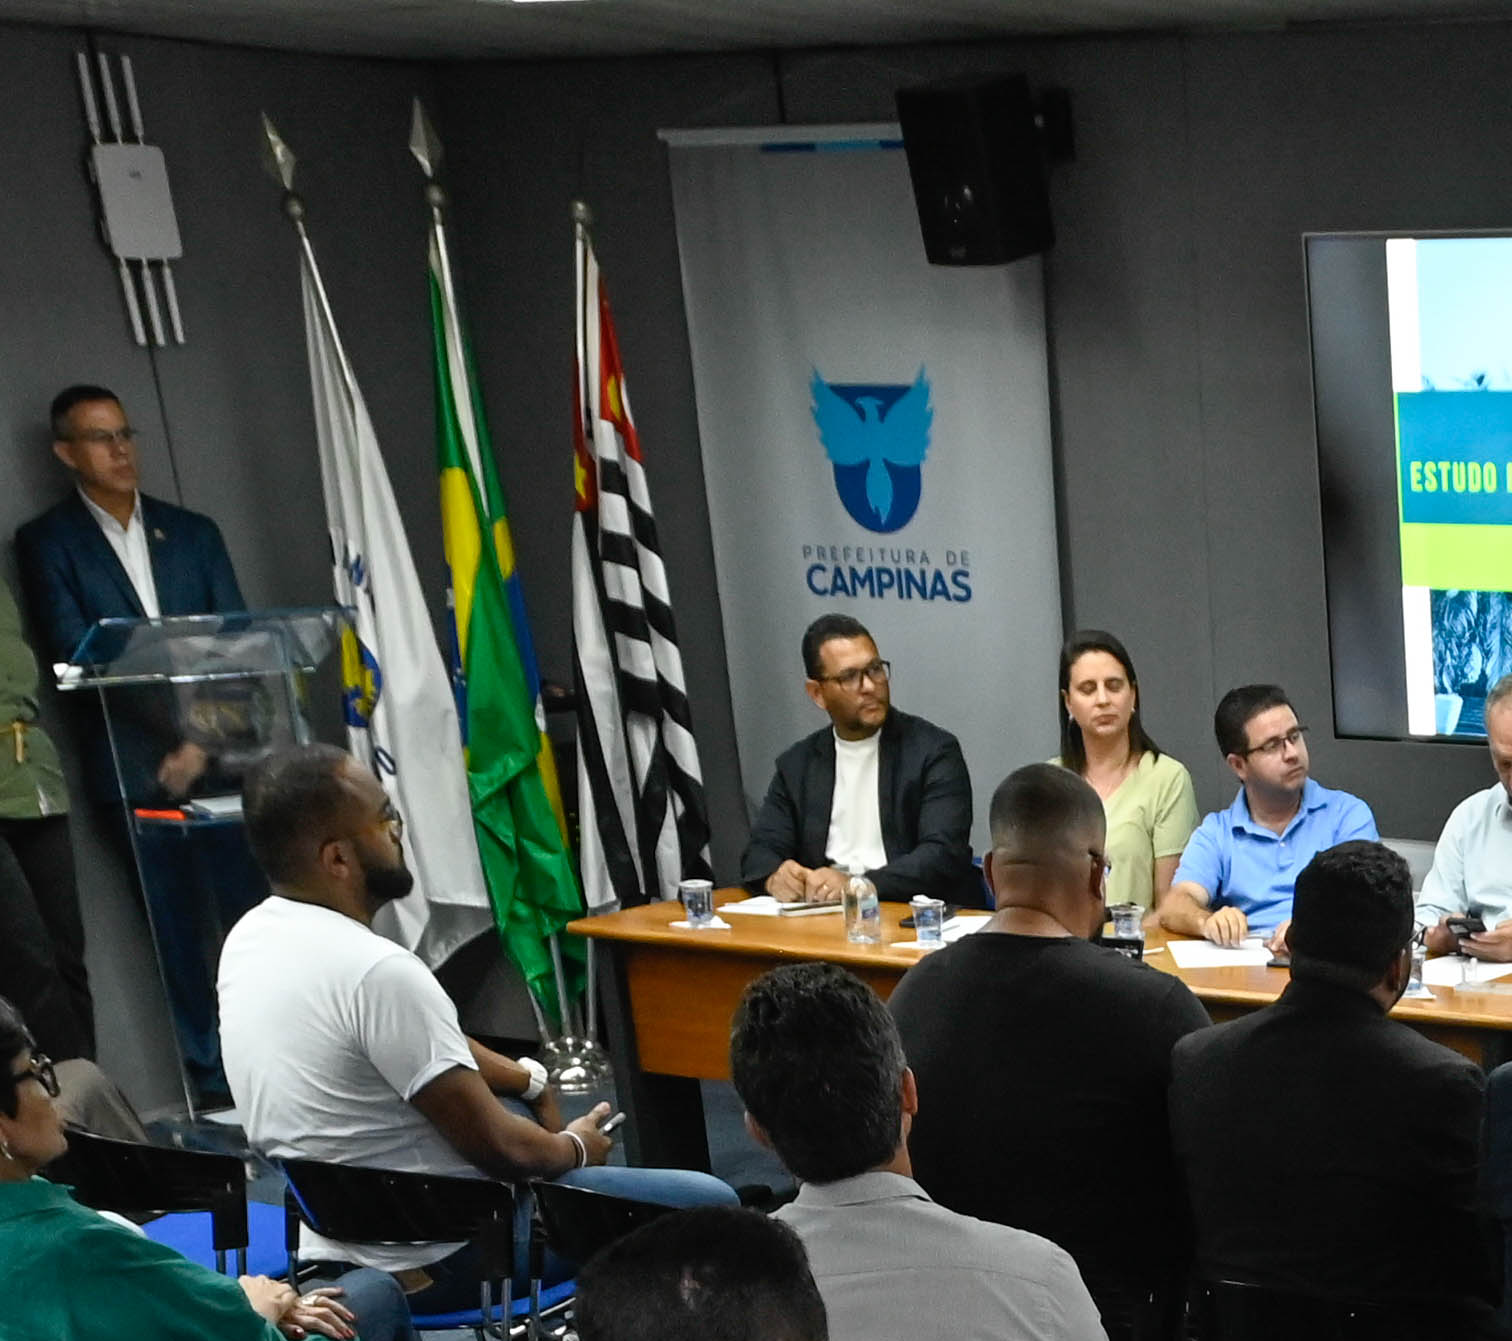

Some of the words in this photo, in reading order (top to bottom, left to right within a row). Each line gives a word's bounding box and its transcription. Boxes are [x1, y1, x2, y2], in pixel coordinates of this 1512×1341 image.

[1410, 461, 1497, 493] ESTUDO
[803, 545, 929, 564] PREFEITURA
[946, 550, 970, 566] DE
[807, 565, 971, 602] CAMPINAS
